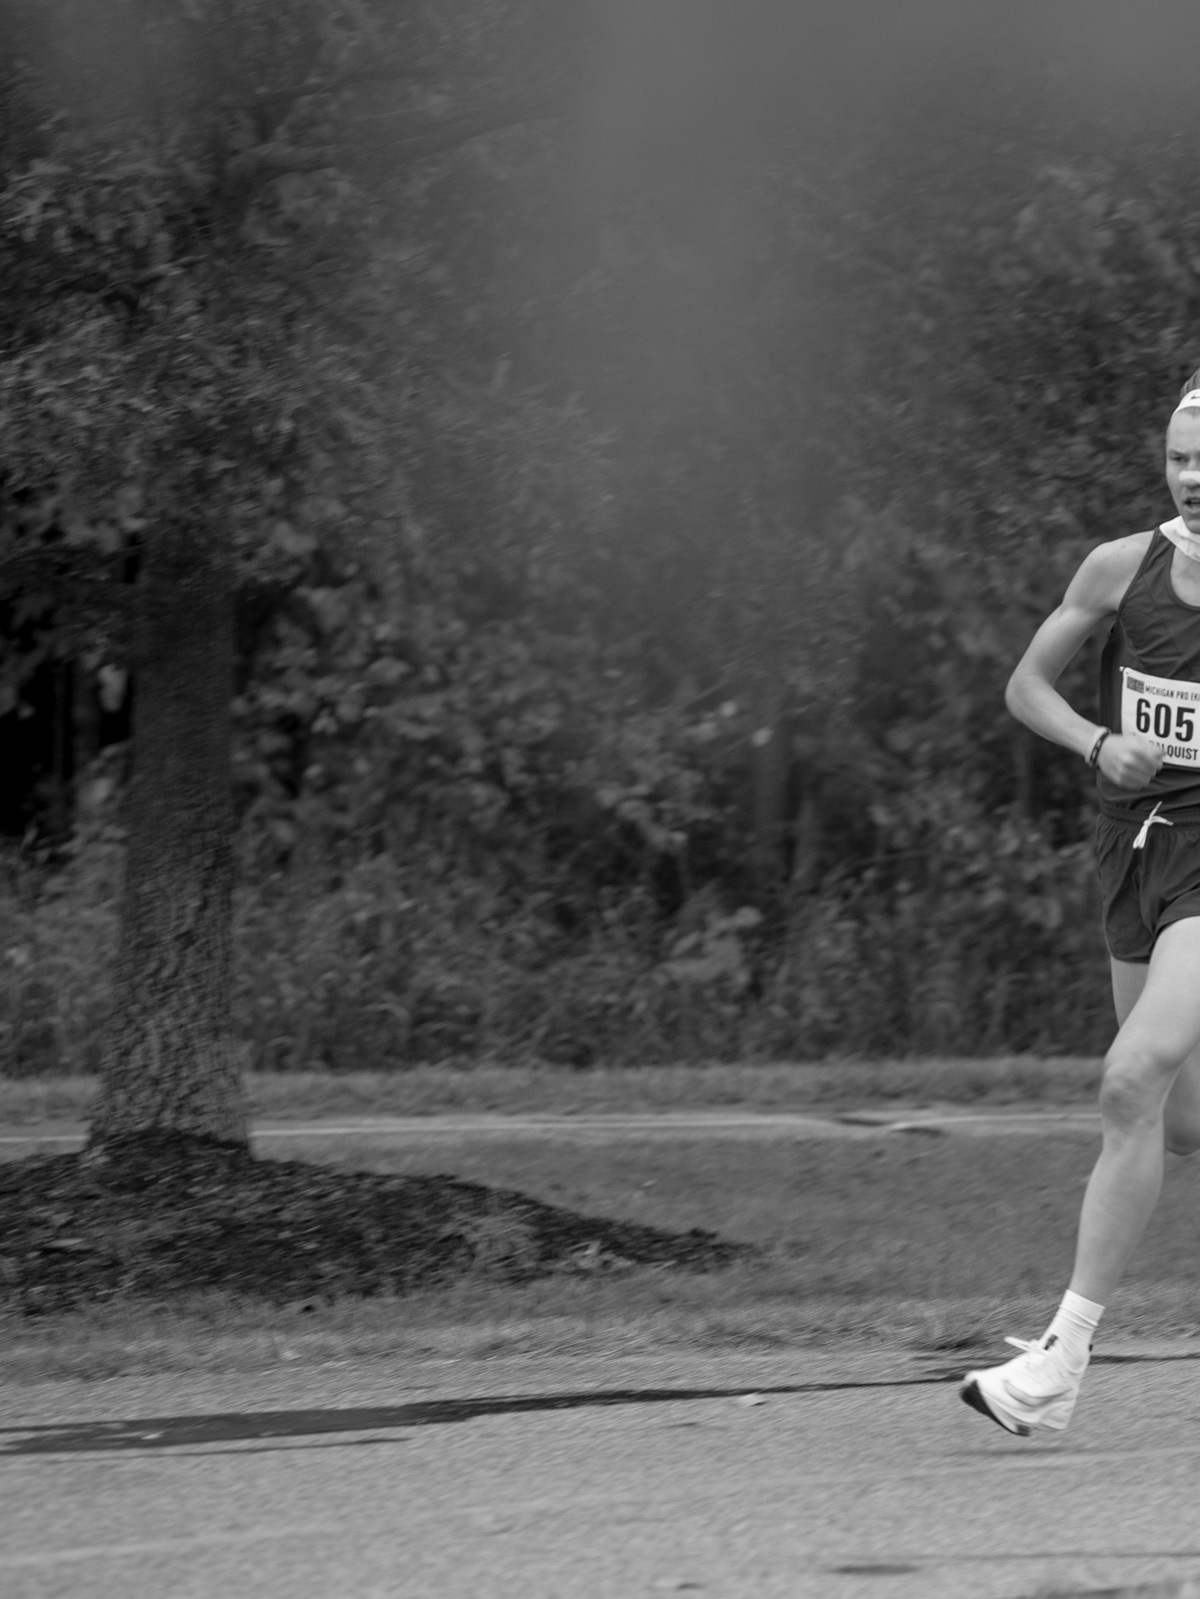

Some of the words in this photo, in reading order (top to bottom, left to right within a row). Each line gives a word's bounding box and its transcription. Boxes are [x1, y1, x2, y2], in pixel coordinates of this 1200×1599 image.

[1145, 685, 1174, 698] MICHIGAN
[1176, 691, 1189, 700] PRO
[1136, 698, 1195, 742] 605
